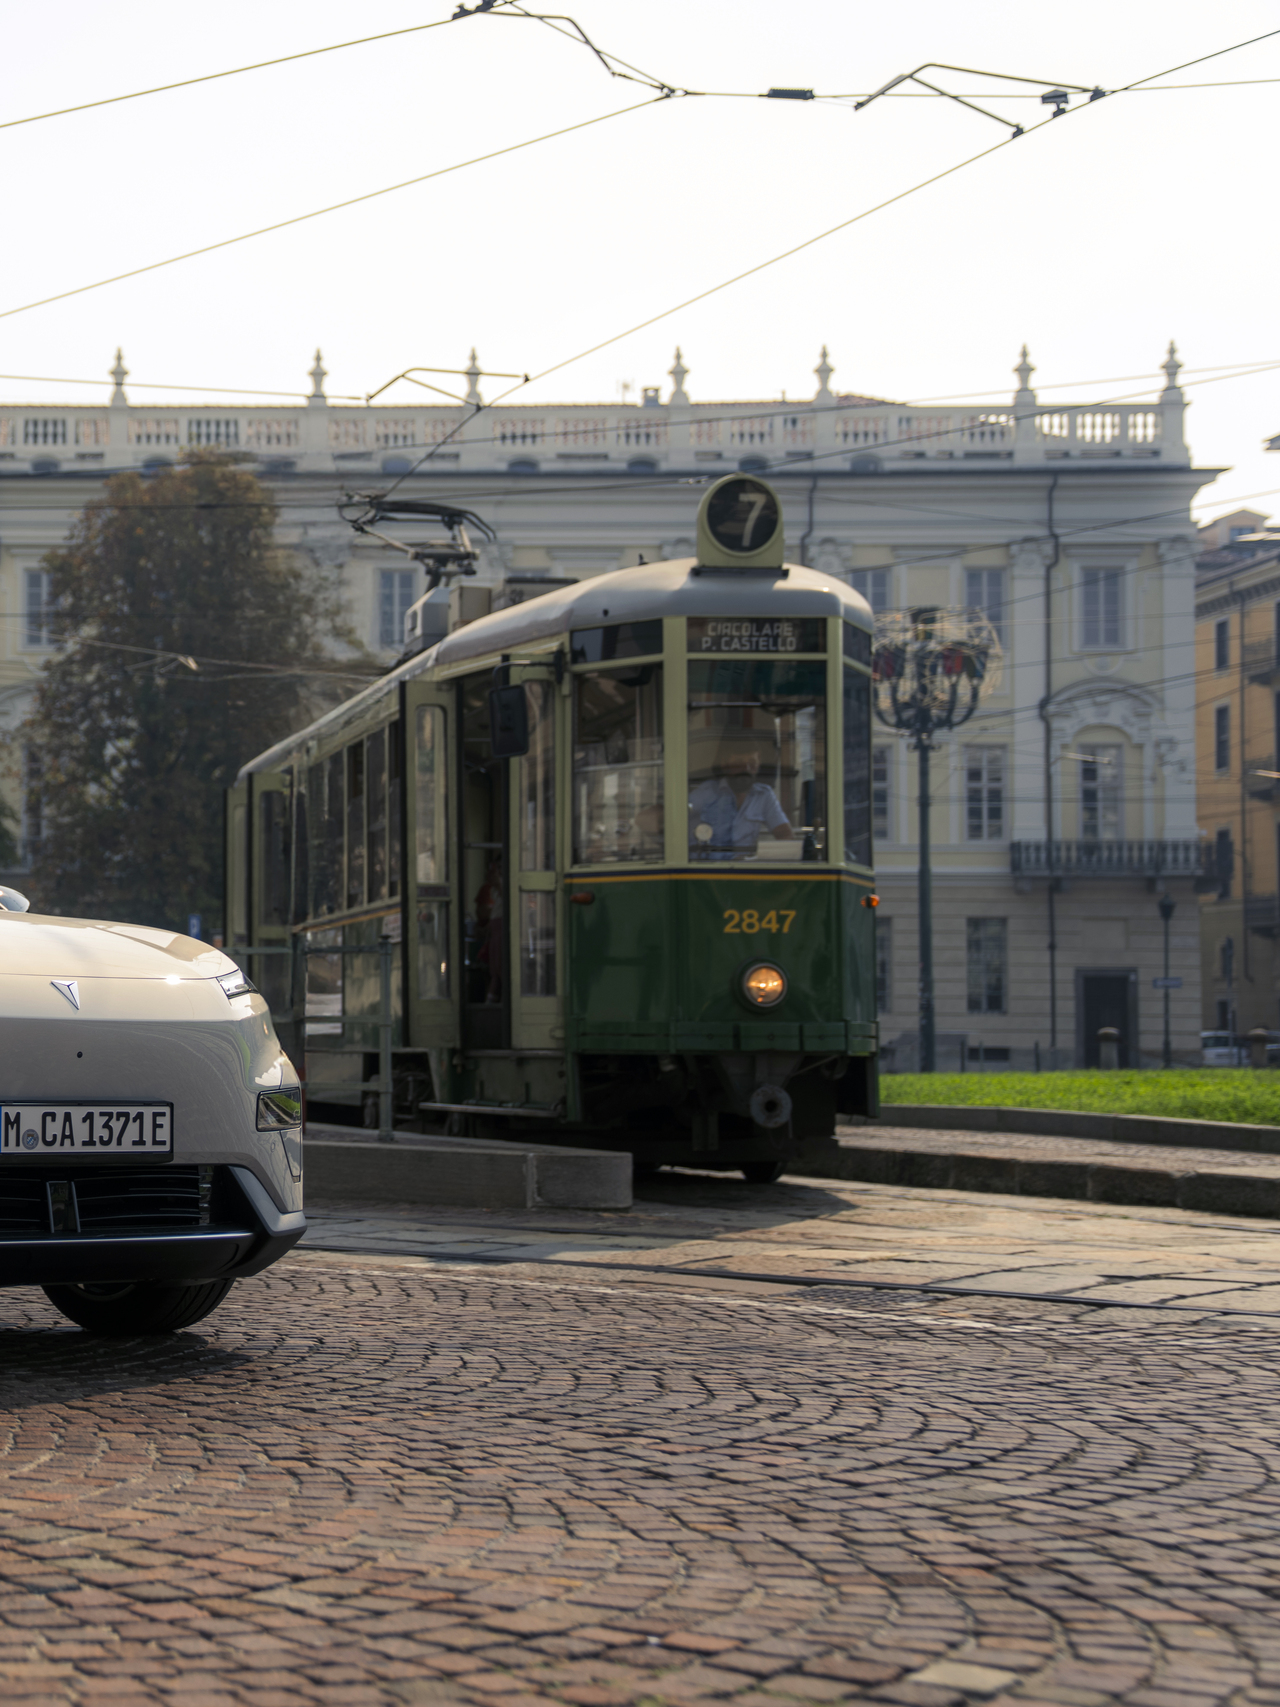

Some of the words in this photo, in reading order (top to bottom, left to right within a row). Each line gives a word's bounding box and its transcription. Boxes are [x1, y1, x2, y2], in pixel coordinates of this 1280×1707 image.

[738, 492, 767, 548] 7
[707, 622, 794, 636] CIRCOLARE
[701, 637, 717, 651] P.
[720, 637, 797, 651] CASTELLO
[723, 909, 796, 933] 2847
[4, 1111, 21, 1147] M
